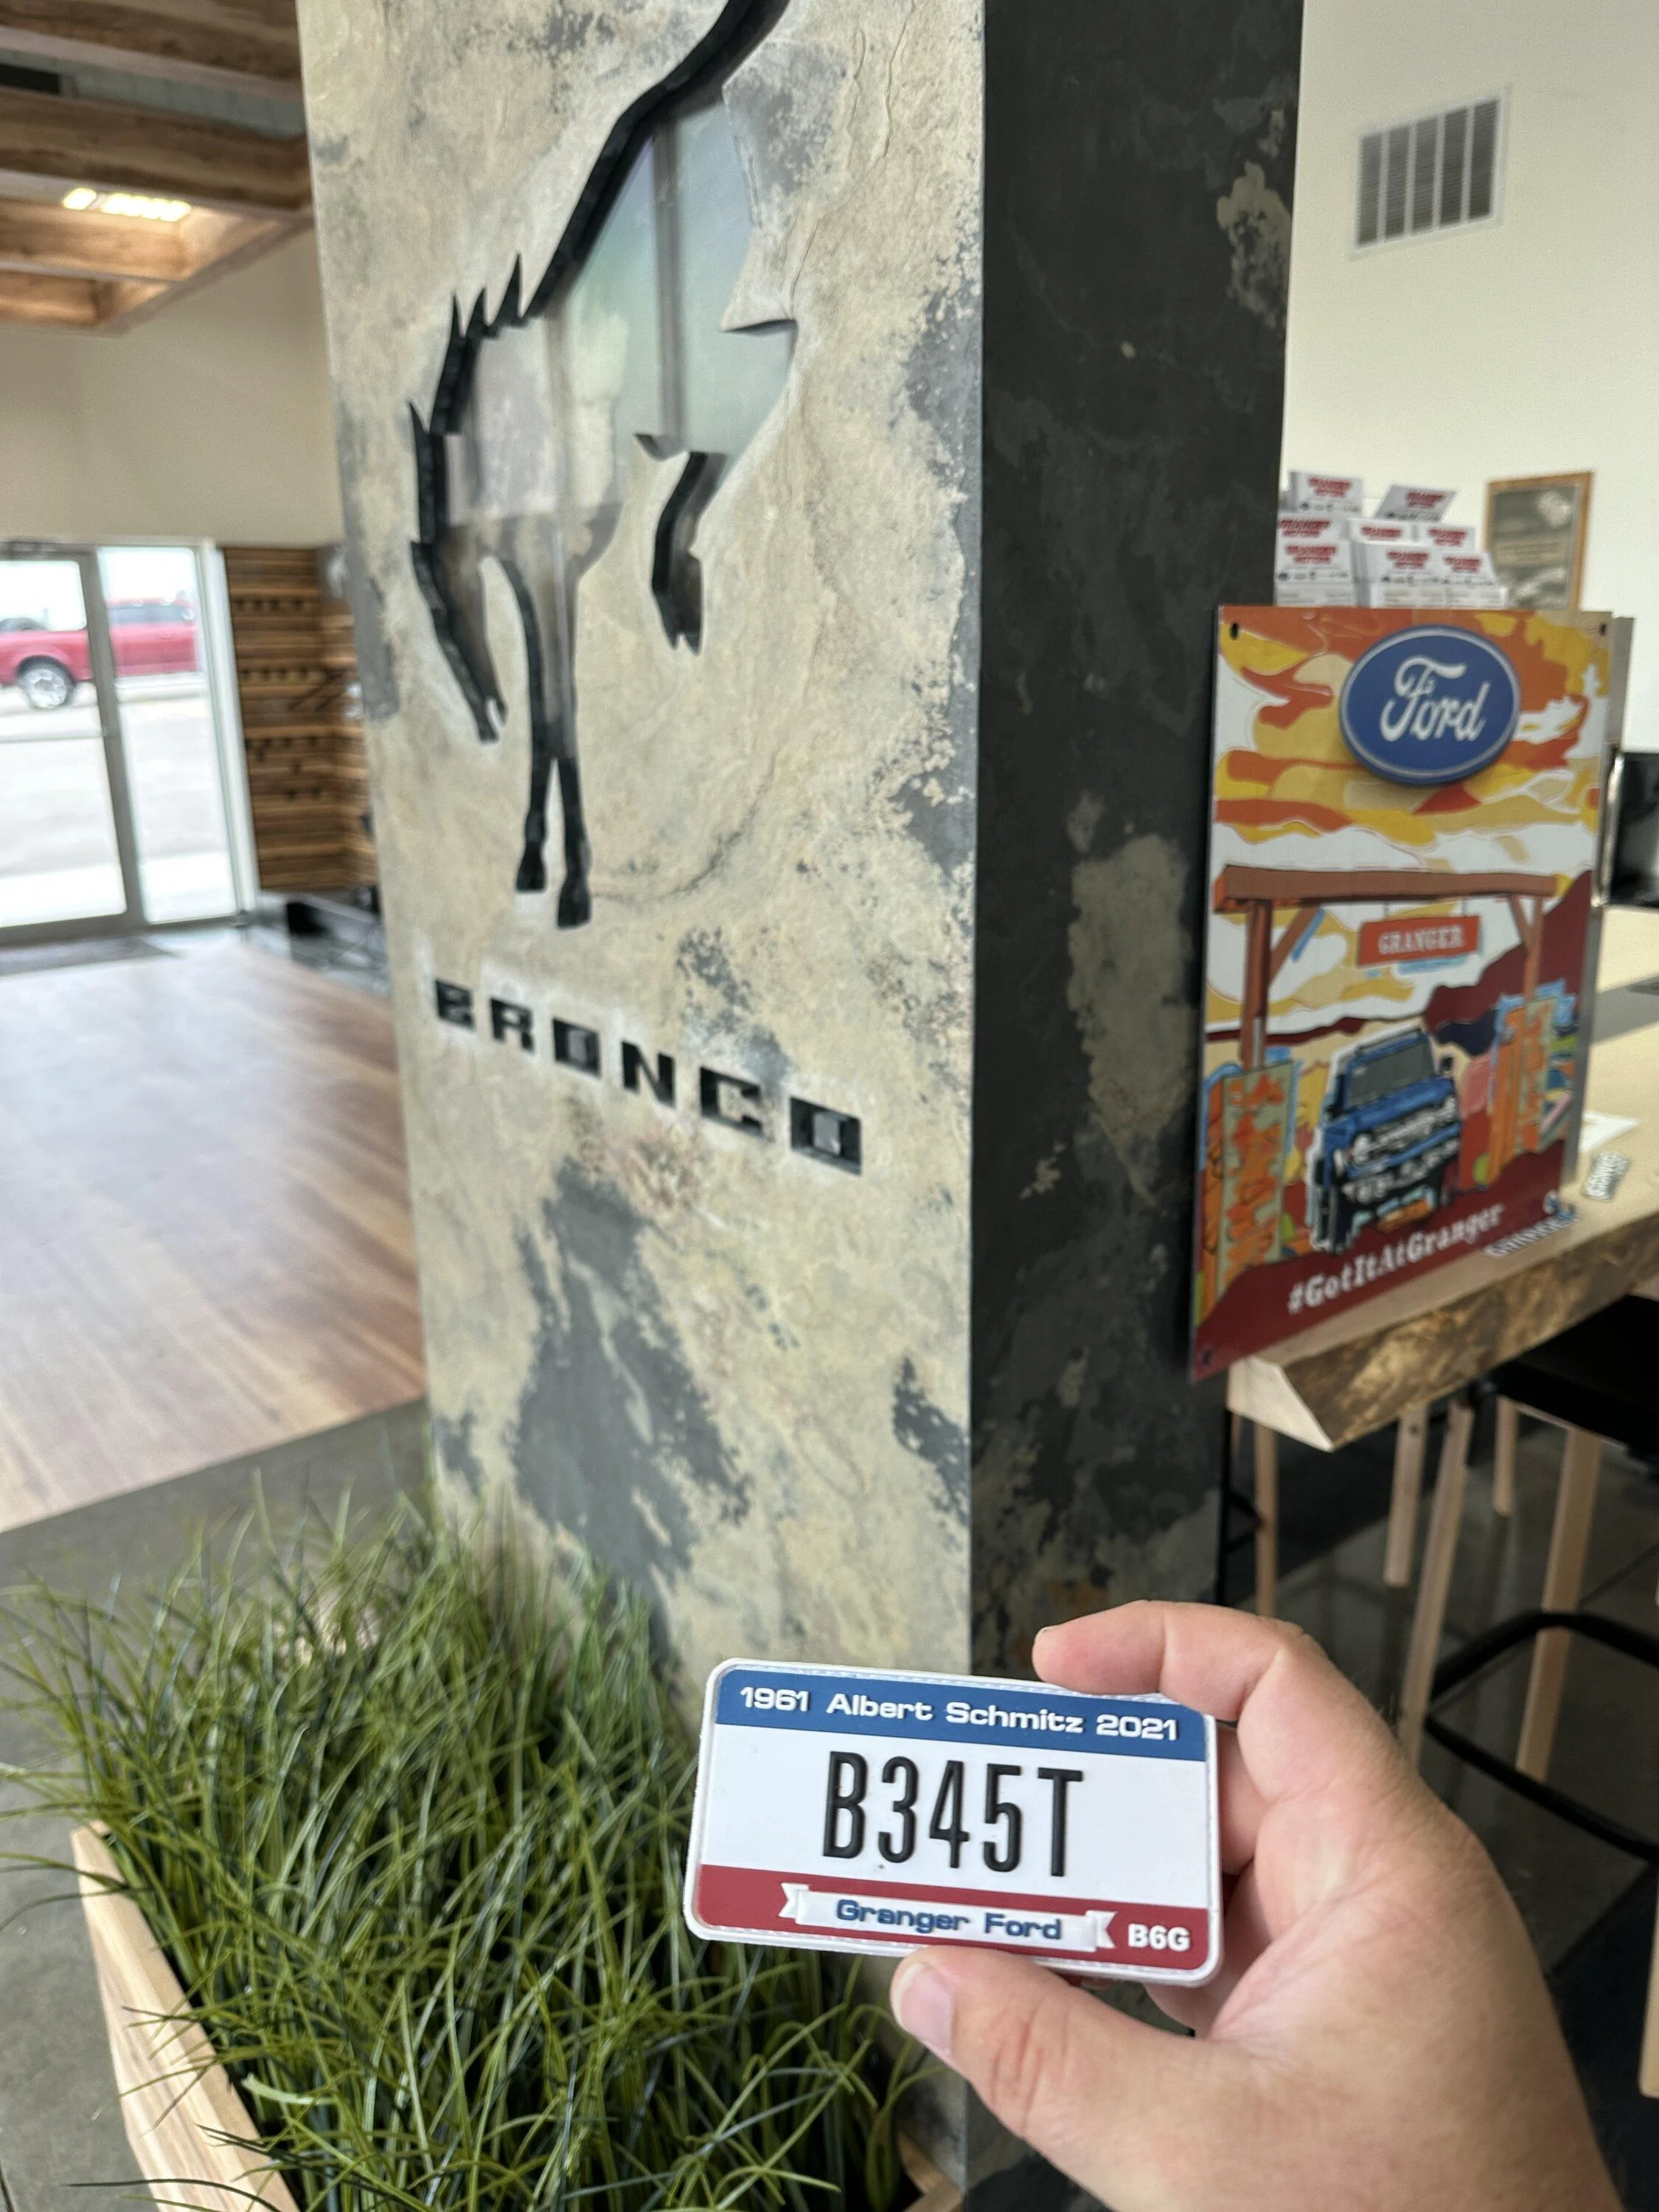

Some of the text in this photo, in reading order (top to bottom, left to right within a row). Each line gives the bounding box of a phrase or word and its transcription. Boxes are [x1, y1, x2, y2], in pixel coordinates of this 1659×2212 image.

[1380, 655, 1490, 742] Ford
[1378, 925, 1464, 955] GRANGER
[434, 978, 863, 1176] BRONCO
[1287, 1203, 1505, 1314] #GotItAtGranger
[740, 1686, 1179, 1742] 1961 Albert Schmitz 2021
[822, 1750, 1084, 1878] B345T
[835, 1898, 1062, 1941] Granger Ford
[1127, 1922, 1192, 1952] B6G
